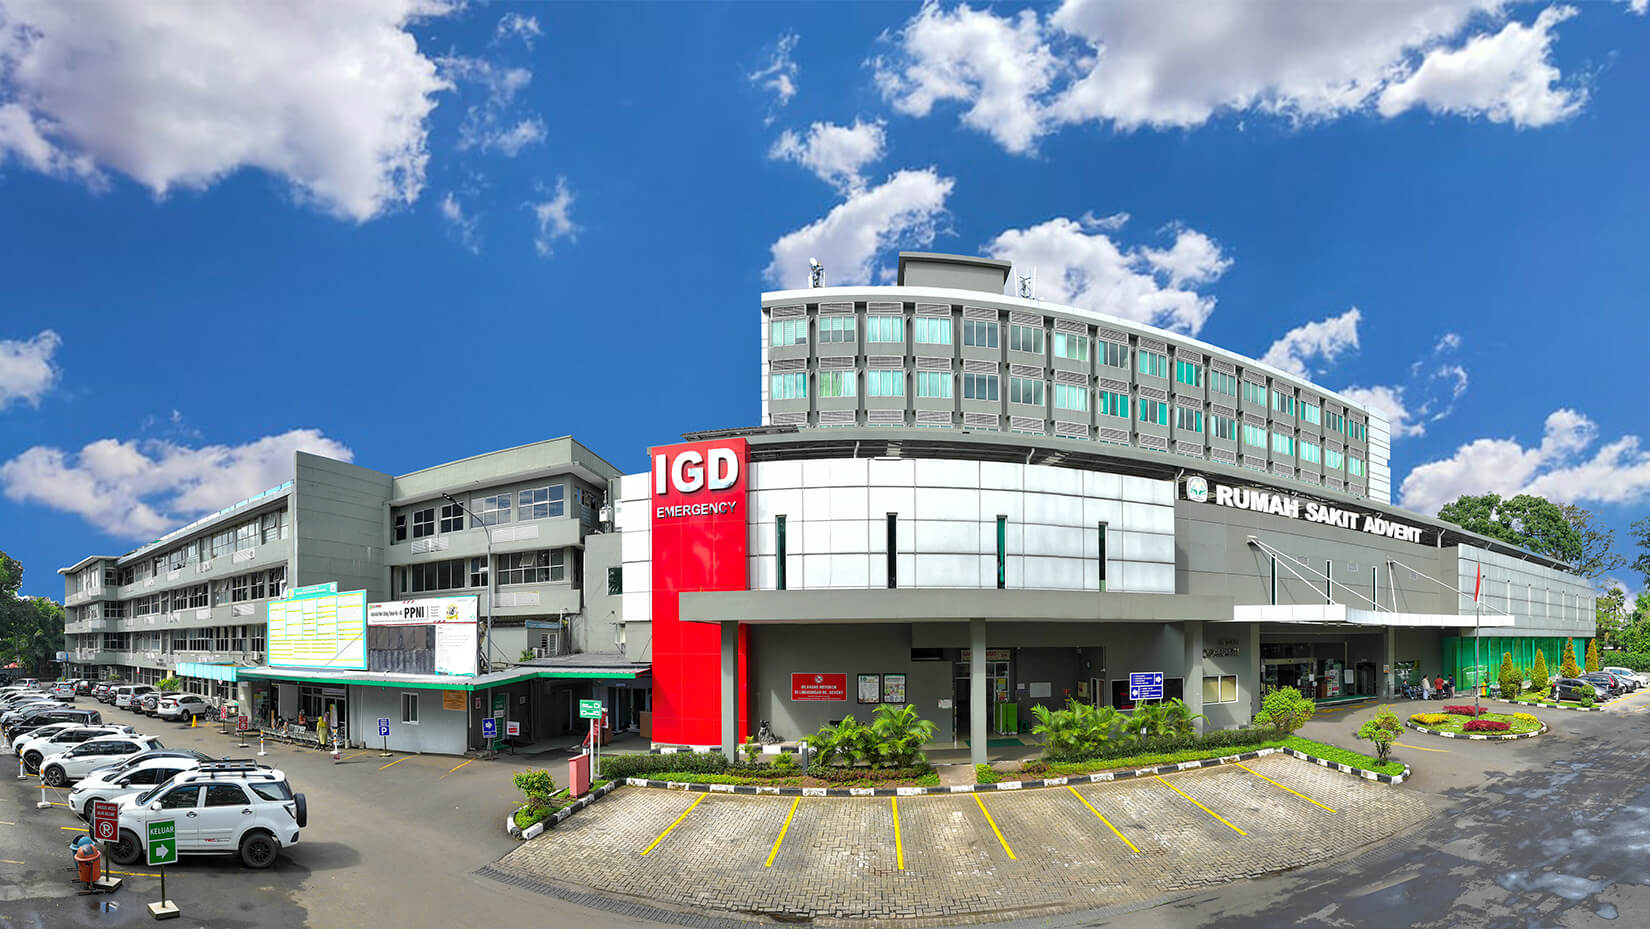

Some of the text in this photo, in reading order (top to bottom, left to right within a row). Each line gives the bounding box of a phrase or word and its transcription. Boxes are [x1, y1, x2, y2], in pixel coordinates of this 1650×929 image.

[655, 448, 739, 494] IGD
[656, 501, 737, 518] EMERGENCY
[1215, 484, 1422, 544] RUMAH SAKIT ADVENT
[404, 606, 425, 619] PPNI
[150, 825, 175, 835] KELUAR
